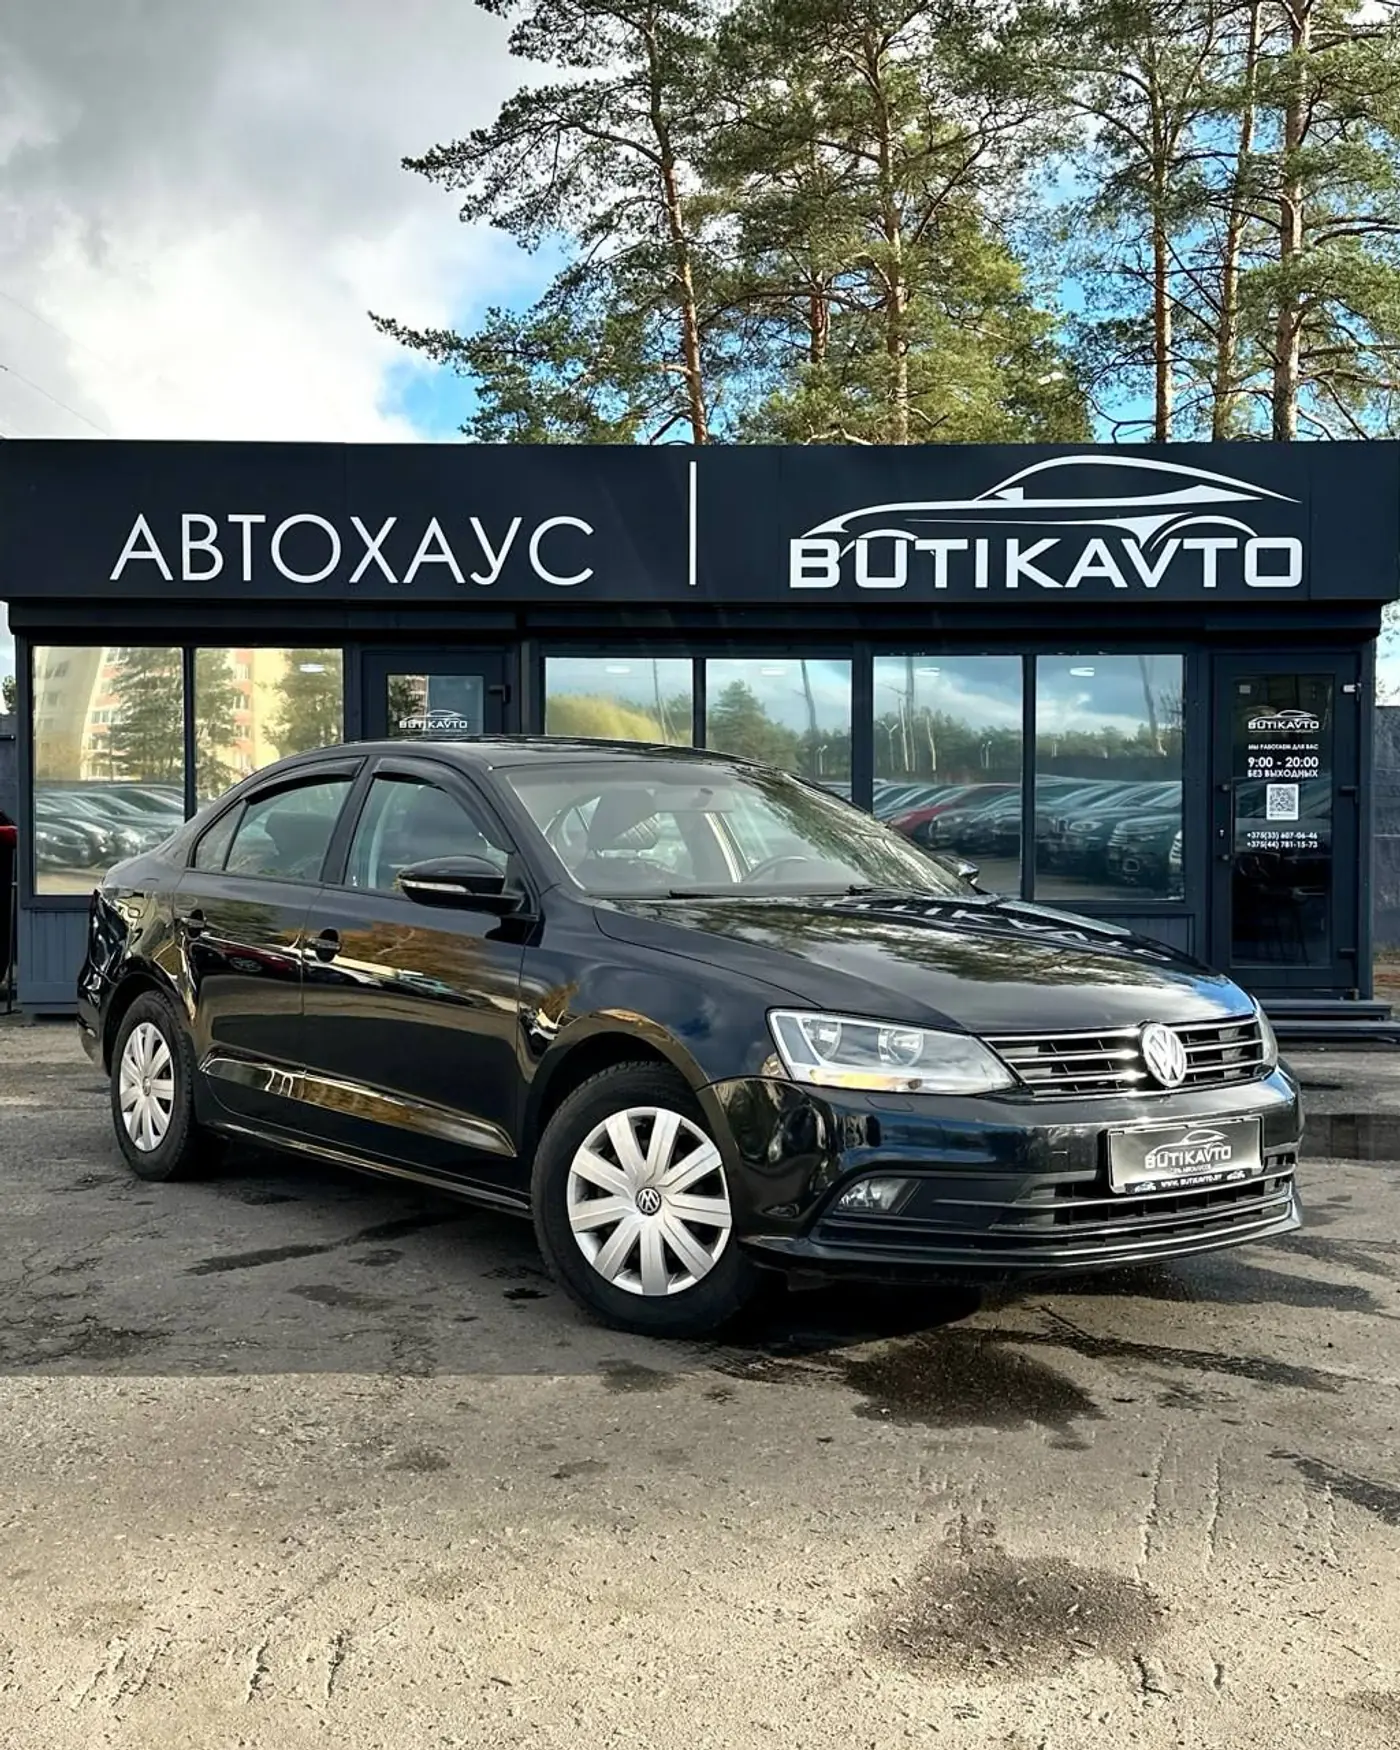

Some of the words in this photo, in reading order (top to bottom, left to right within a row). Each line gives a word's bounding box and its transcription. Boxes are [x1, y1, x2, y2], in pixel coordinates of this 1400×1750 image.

[109, 513, 595, 587] АВТОХАУС
[789, 535, 1304, 589] BUTIKAVTO
[399, 720, 468, 729] BUTIKAVTO
[1248, 720, 1320, 729] BUTIKAVTO
[1248, 756, 1273, 768] 9:00
[1285, 756, 1319, 768] 20:00
[1247, 769, 1263, 778] БЕЗ
[1264, 769, 1318, 779] ВЫХОДНЫХ
[1144, 1145, 1232, 1169] BUTIKAVTO
